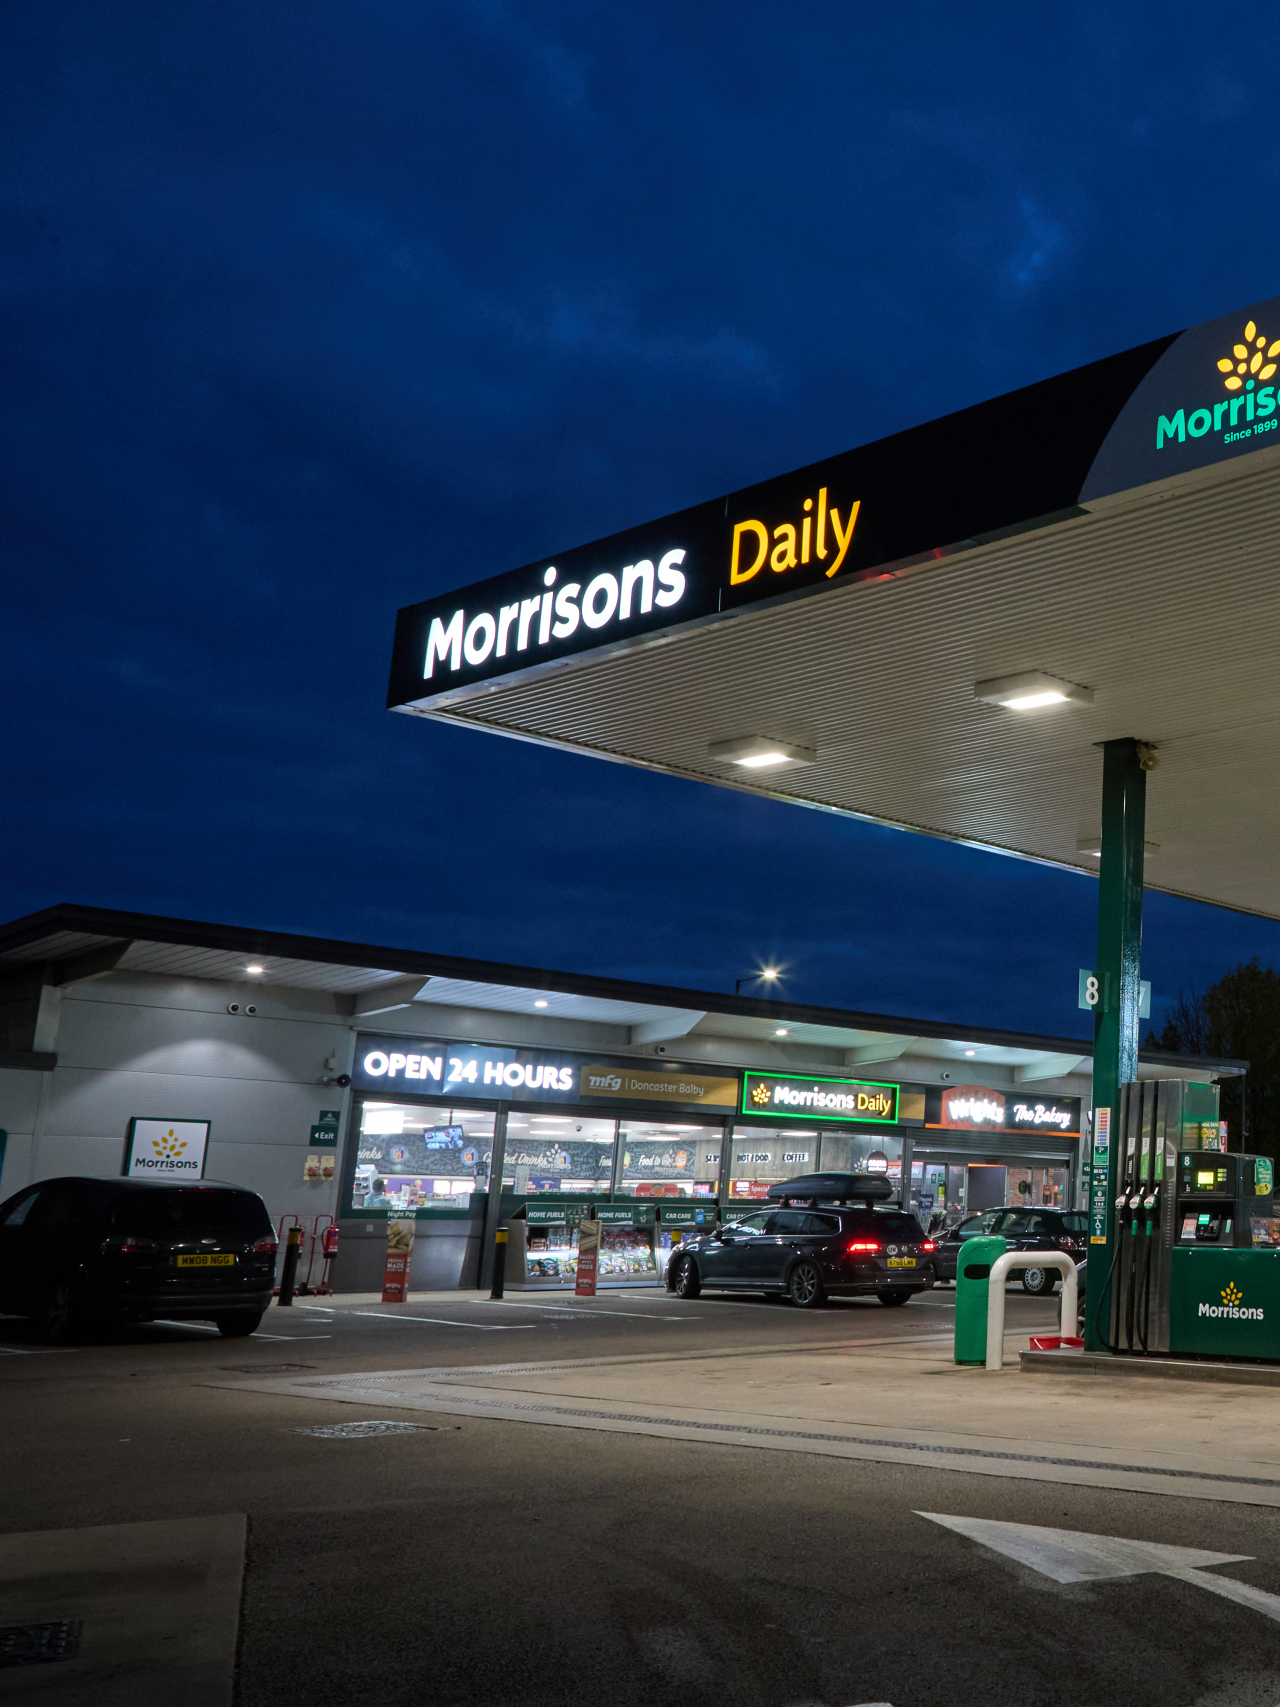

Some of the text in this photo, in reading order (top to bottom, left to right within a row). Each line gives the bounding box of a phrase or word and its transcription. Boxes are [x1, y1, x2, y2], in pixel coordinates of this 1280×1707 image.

[1223, 418, 1278, 444] Since 1899
[423, 487, 860, 679] Morrisons Daily
[1085, 976, 1099, 1005] 8
[363, 1051, 573, 1091] OPEN 24 HOURS
[589, 1074, 704, 1097] mfg Doncaster Balby
[774, 1085, 891, 1117] Morrisons Daily
[1013, 1104, 1035, 1122] The
[1034, 1104, 1071, 1129] Bakery
[320, 1131, 335, 1140] Exit
[135, 1154, 199, 1169] Morrisons
[358, 1146, 382, 1159] rinks
[751, 1153, 770, 1163] FOOD
[782, 1152, 809, 1163] COFFEE
[1184, 1156, 1190, 1166] 8
[1198, 1302, 1264, 1320] Morrisons
